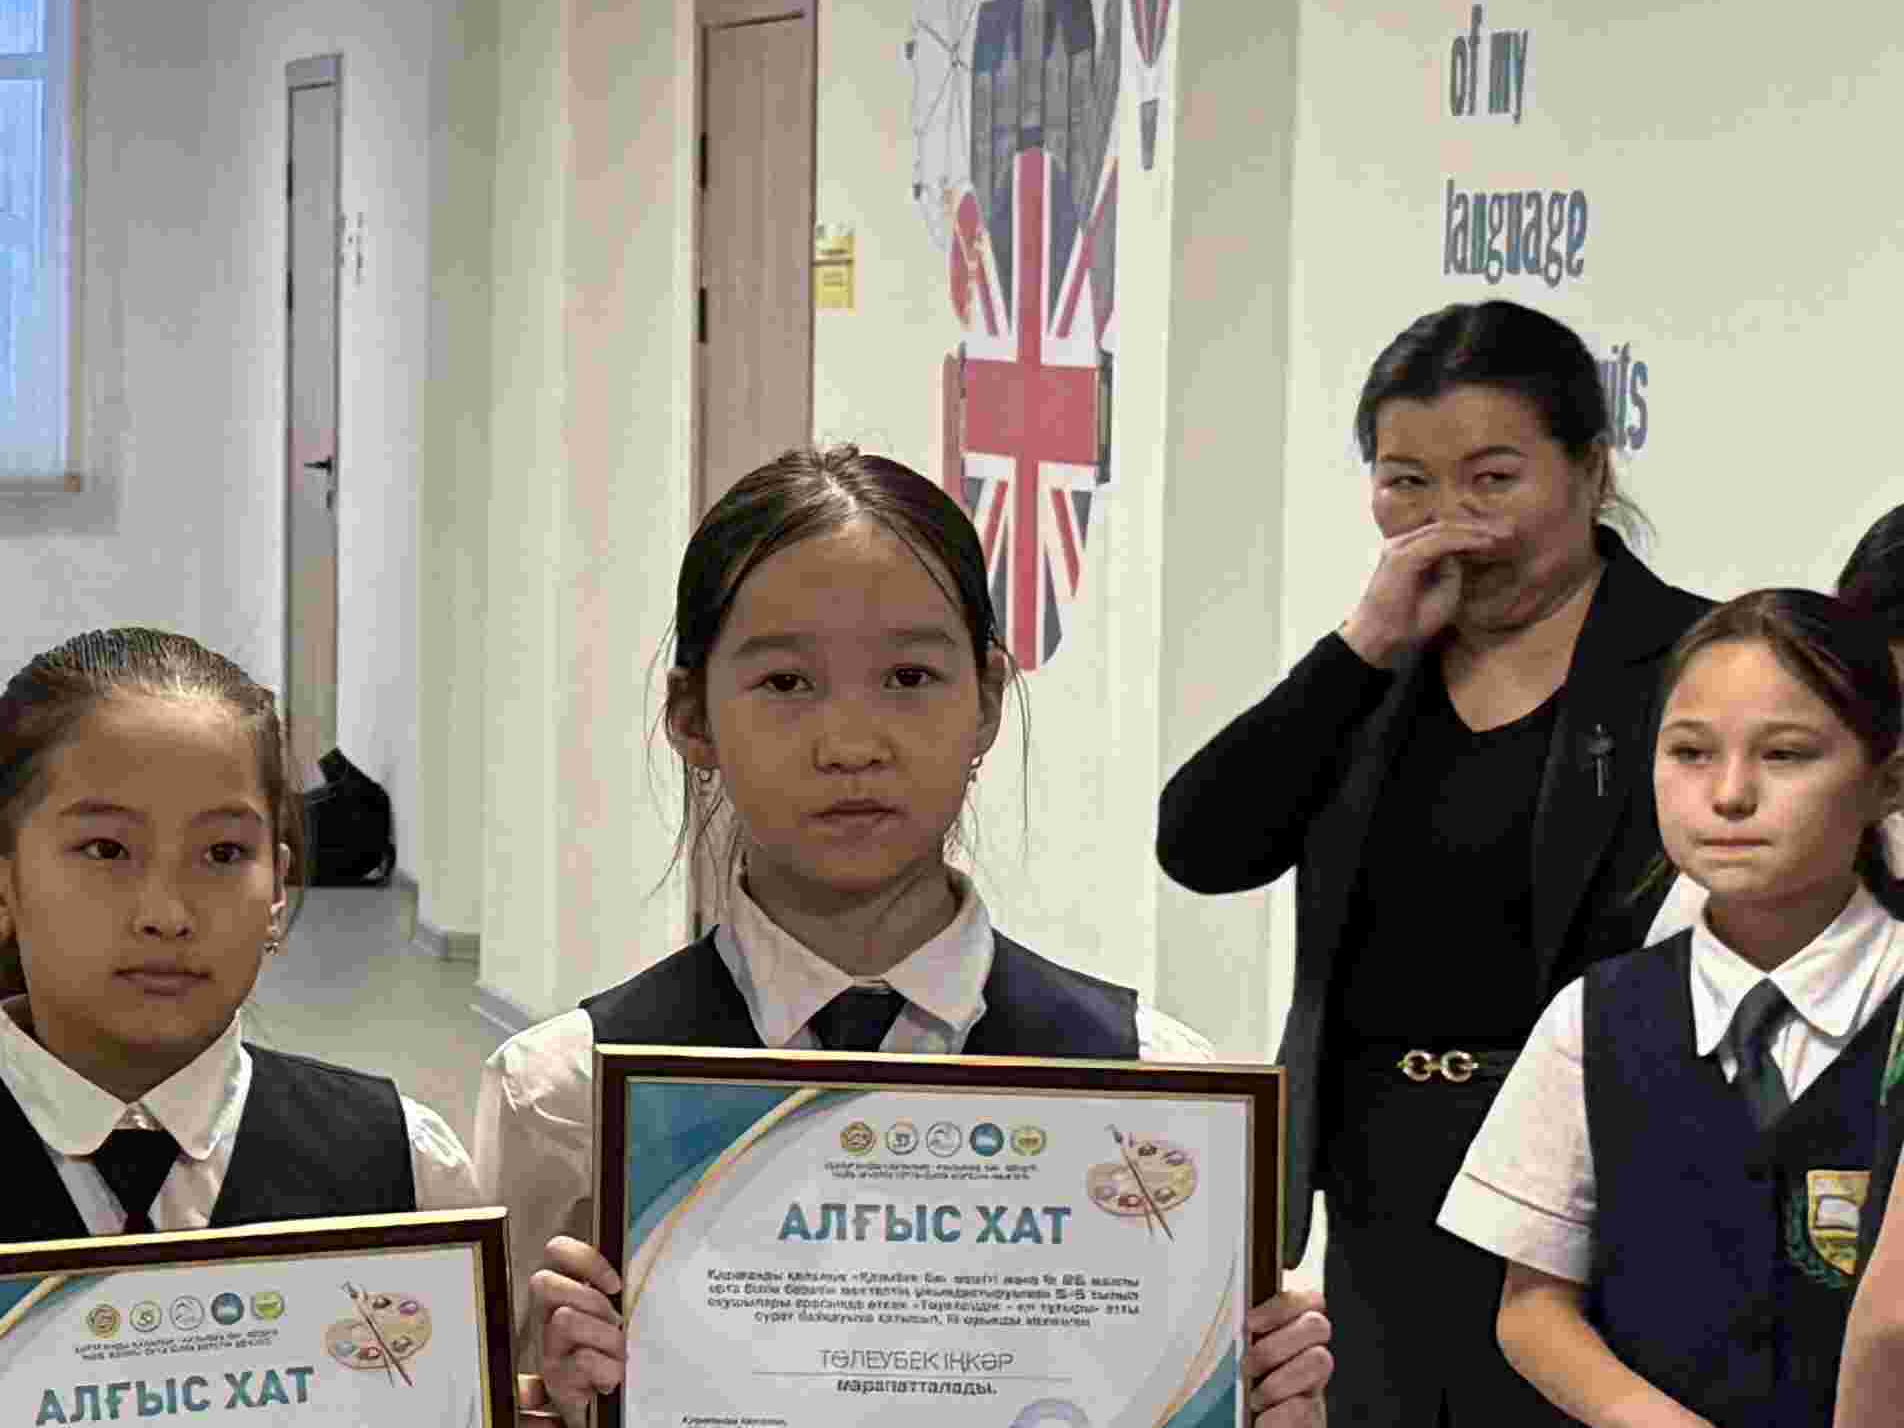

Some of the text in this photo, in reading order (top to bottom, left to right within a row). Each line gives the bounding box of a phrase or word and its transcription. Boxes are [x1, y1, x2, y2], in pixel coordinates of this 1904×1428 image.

[1450, 4, 1528, 125] of my
[1444, 179, 1588, 288] language
[777, 1203, 1072, 1244] АЛҒЫС ХАТ
[36, 1366, 314, 1427] АЛҒЫС ХАТ
